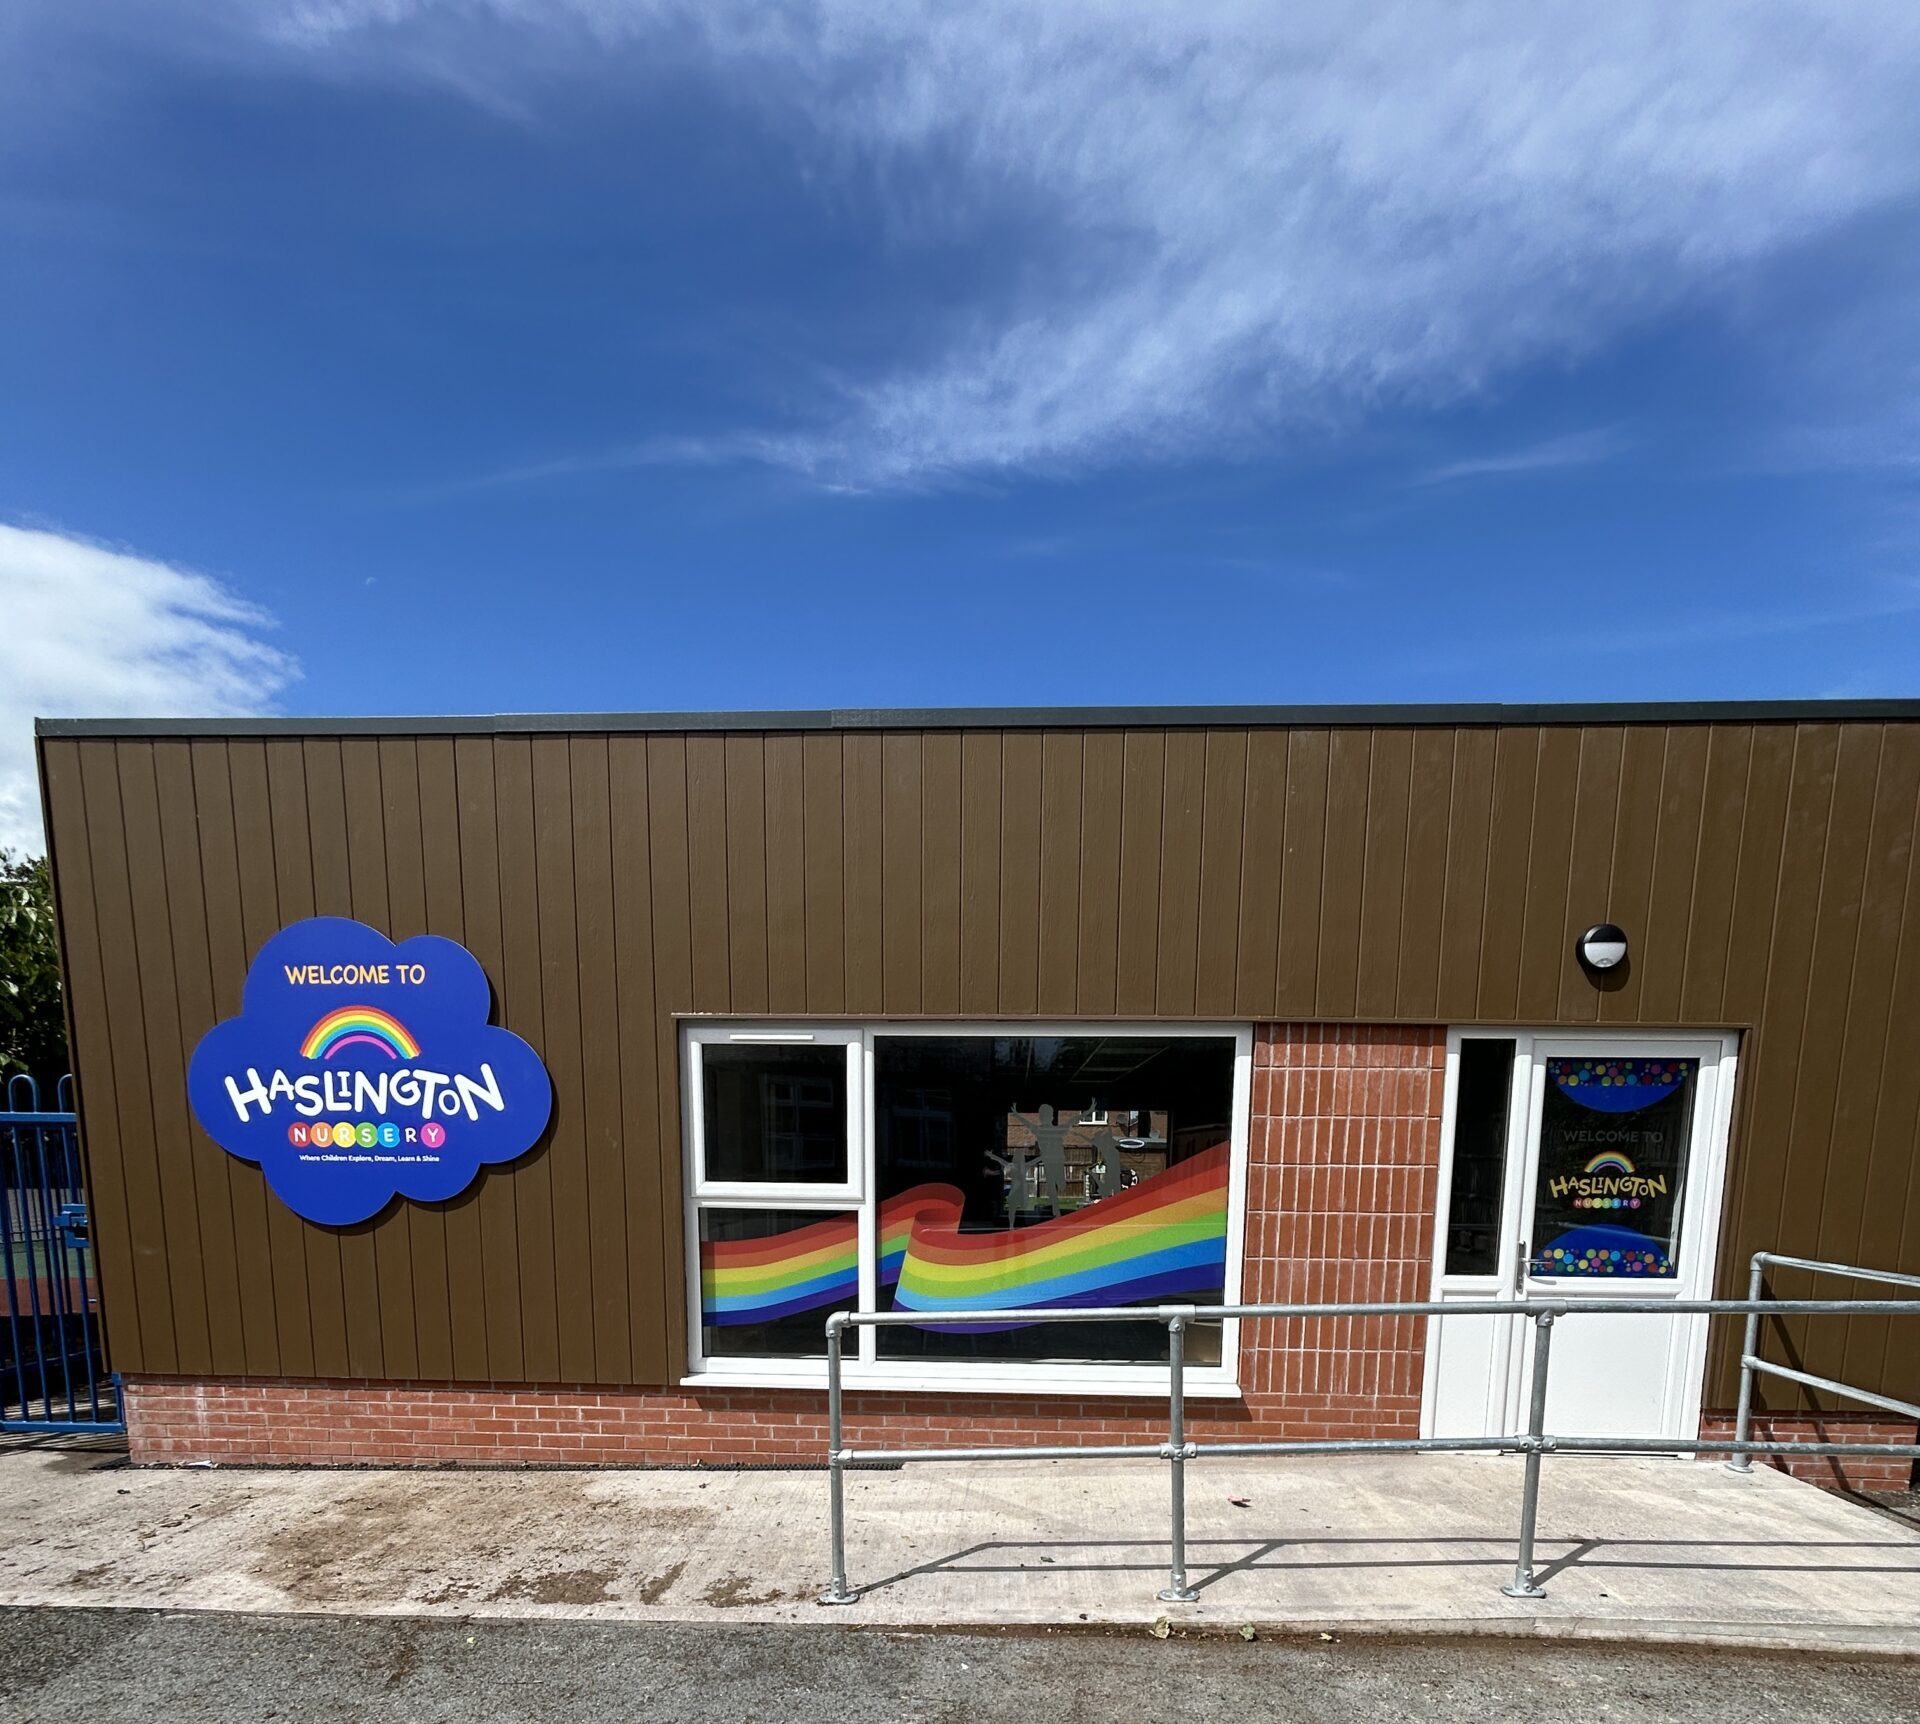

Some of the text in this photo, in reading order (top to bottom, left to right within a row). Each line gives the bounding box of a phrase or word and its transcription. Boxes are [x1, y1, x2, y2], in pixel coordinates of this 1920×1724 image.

[284, 964, 426, 985] WELCOME TO
[224, 1063, 505, 1122] HASLINGTON
[292, 1126, 440, 1144] NURSERY
[1564, 1130, 1664, 1144] WELCOME TO
[349, 1155, 374, 1163] Explore,
[375, 1155, 397, 1163] Dream,
[1550, 1175, 1667, 1198] HASLINGTON
[1574, 1199, 1639, 1208] NUSERY
